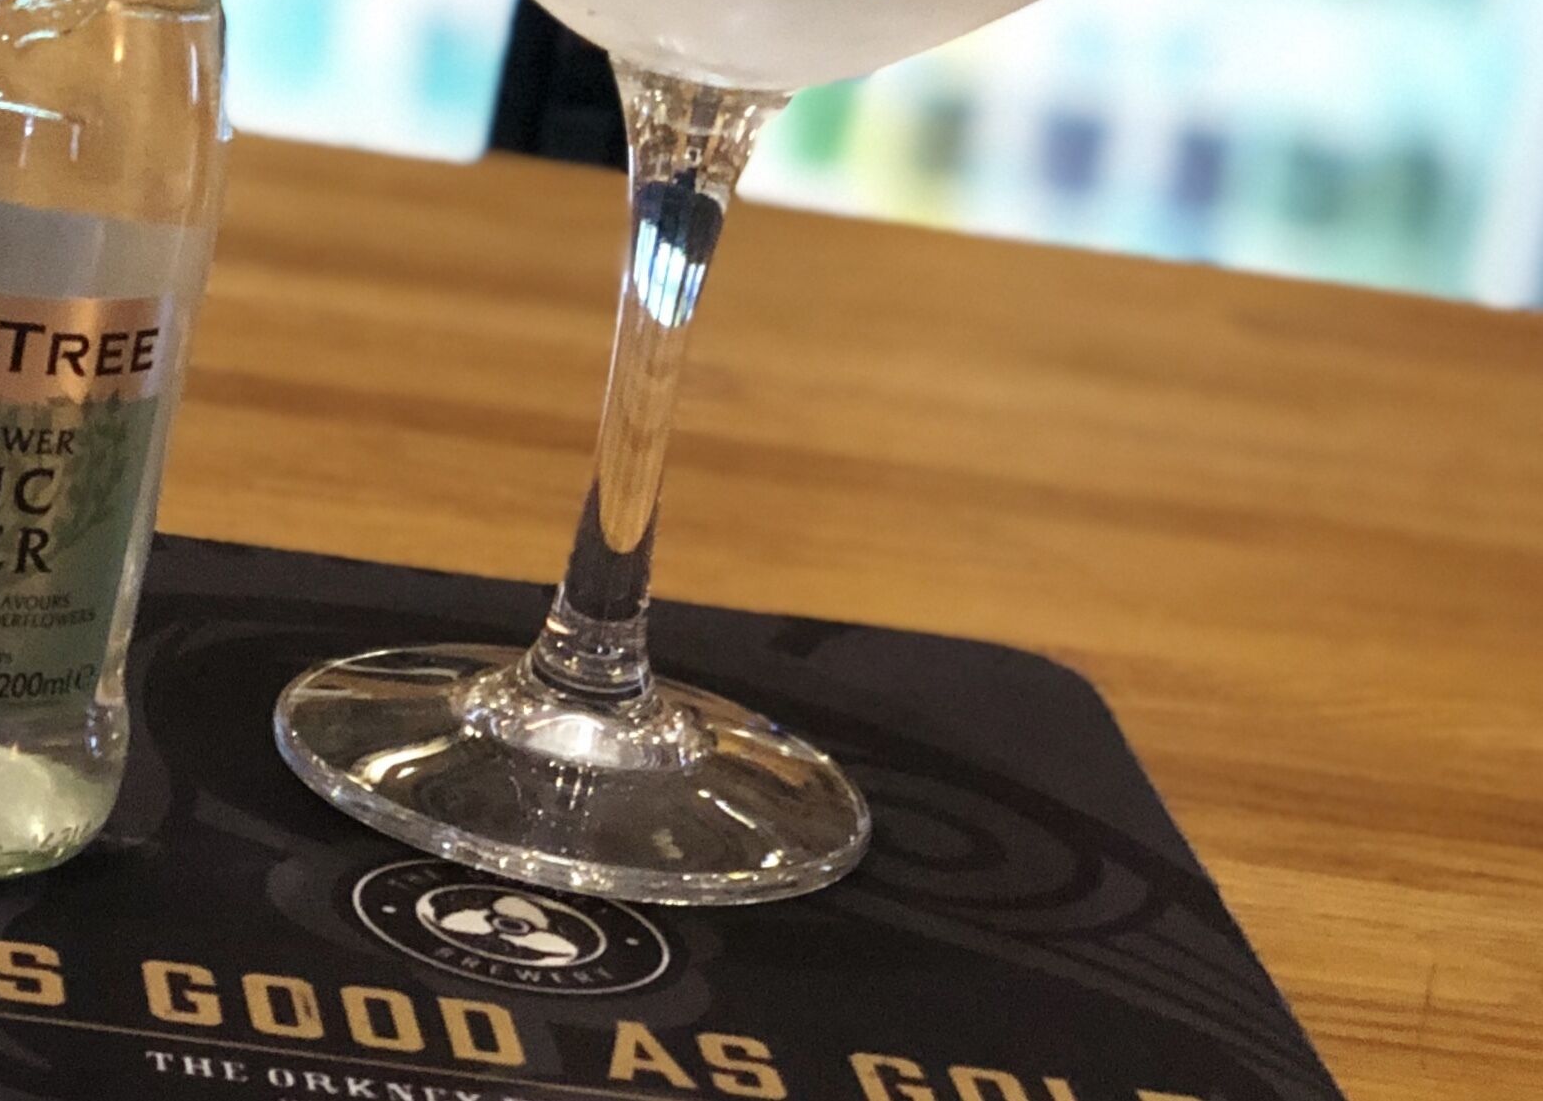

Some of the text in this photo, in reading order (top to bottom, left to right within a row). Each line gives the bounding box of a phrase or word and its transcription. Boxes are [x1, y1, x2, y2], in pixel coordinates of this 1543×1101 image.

[142, 959, 526, 1068] GOOD
[607, 1020, 788, 1100] AS
[145, 1049, 250, 1082] THE
